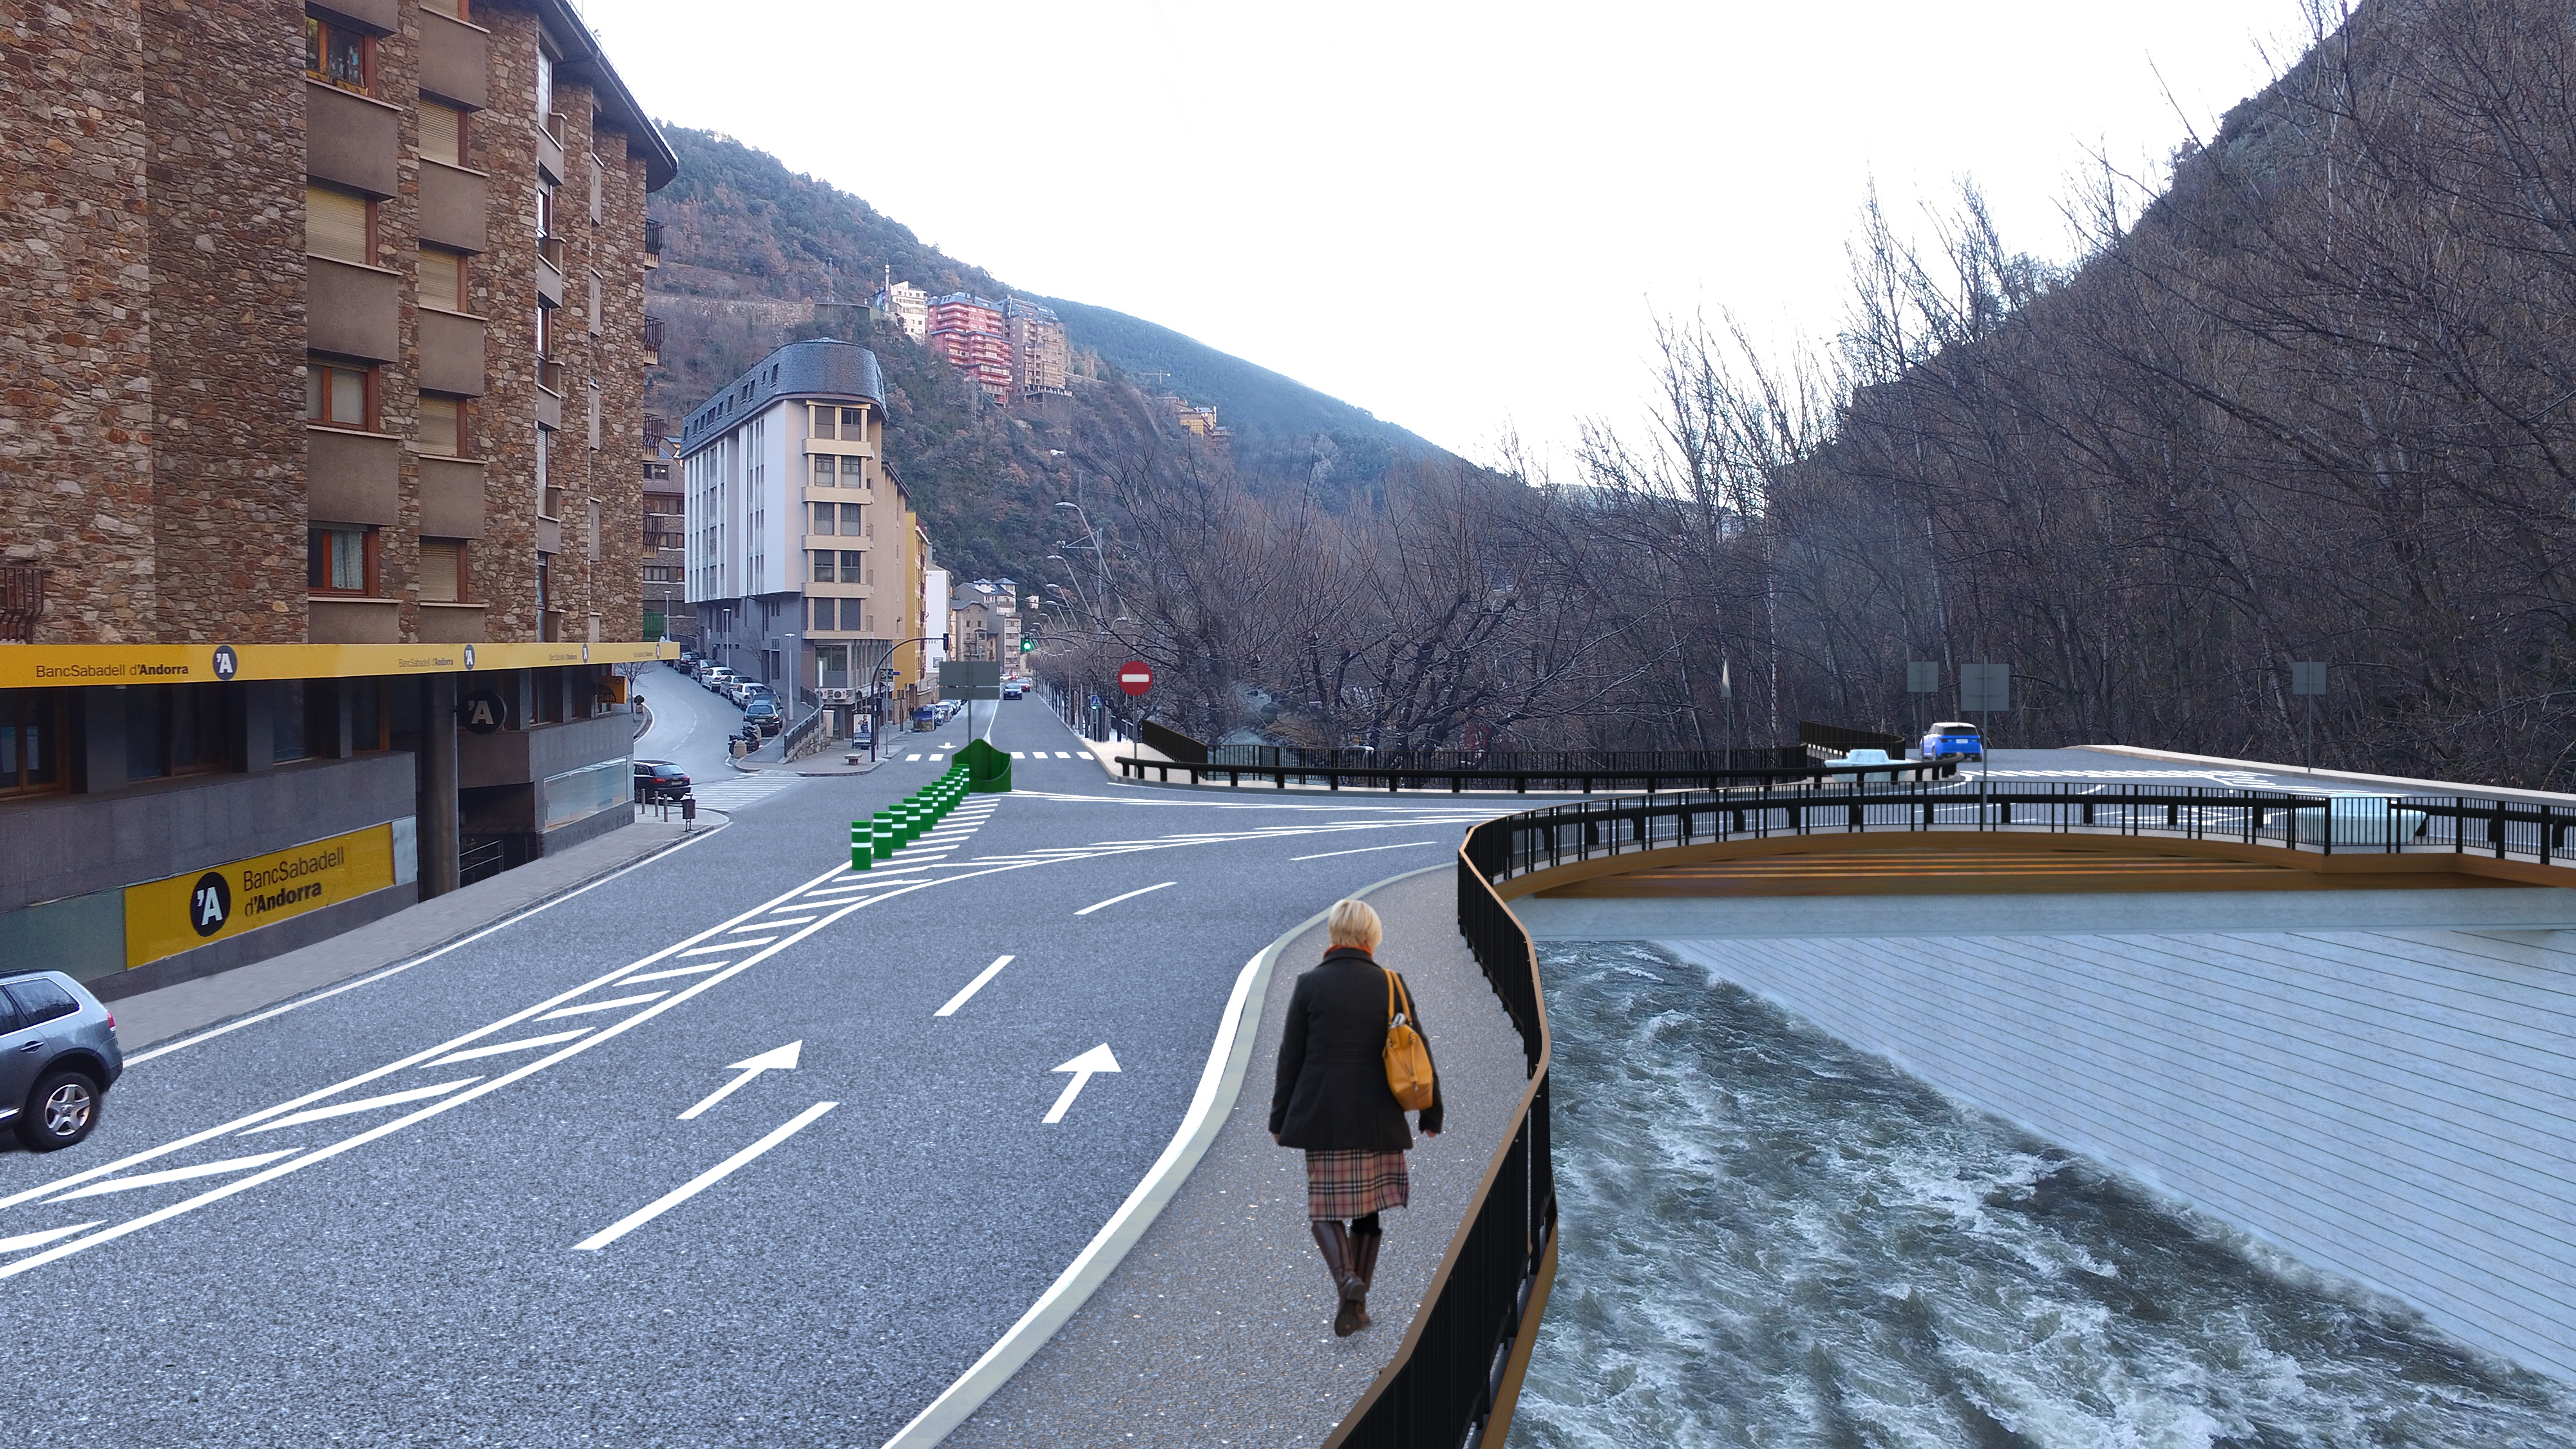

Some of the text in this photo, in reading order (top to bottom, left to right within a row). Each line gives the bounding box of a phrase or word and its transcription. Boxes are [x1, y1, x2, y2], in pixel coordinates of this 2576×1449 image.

[36, 664, 189, 677] BancSabadell d'Andorra
[243, 846, 345, 892] BancSabadell
[245, 882, 322, 917] d'Andorra
